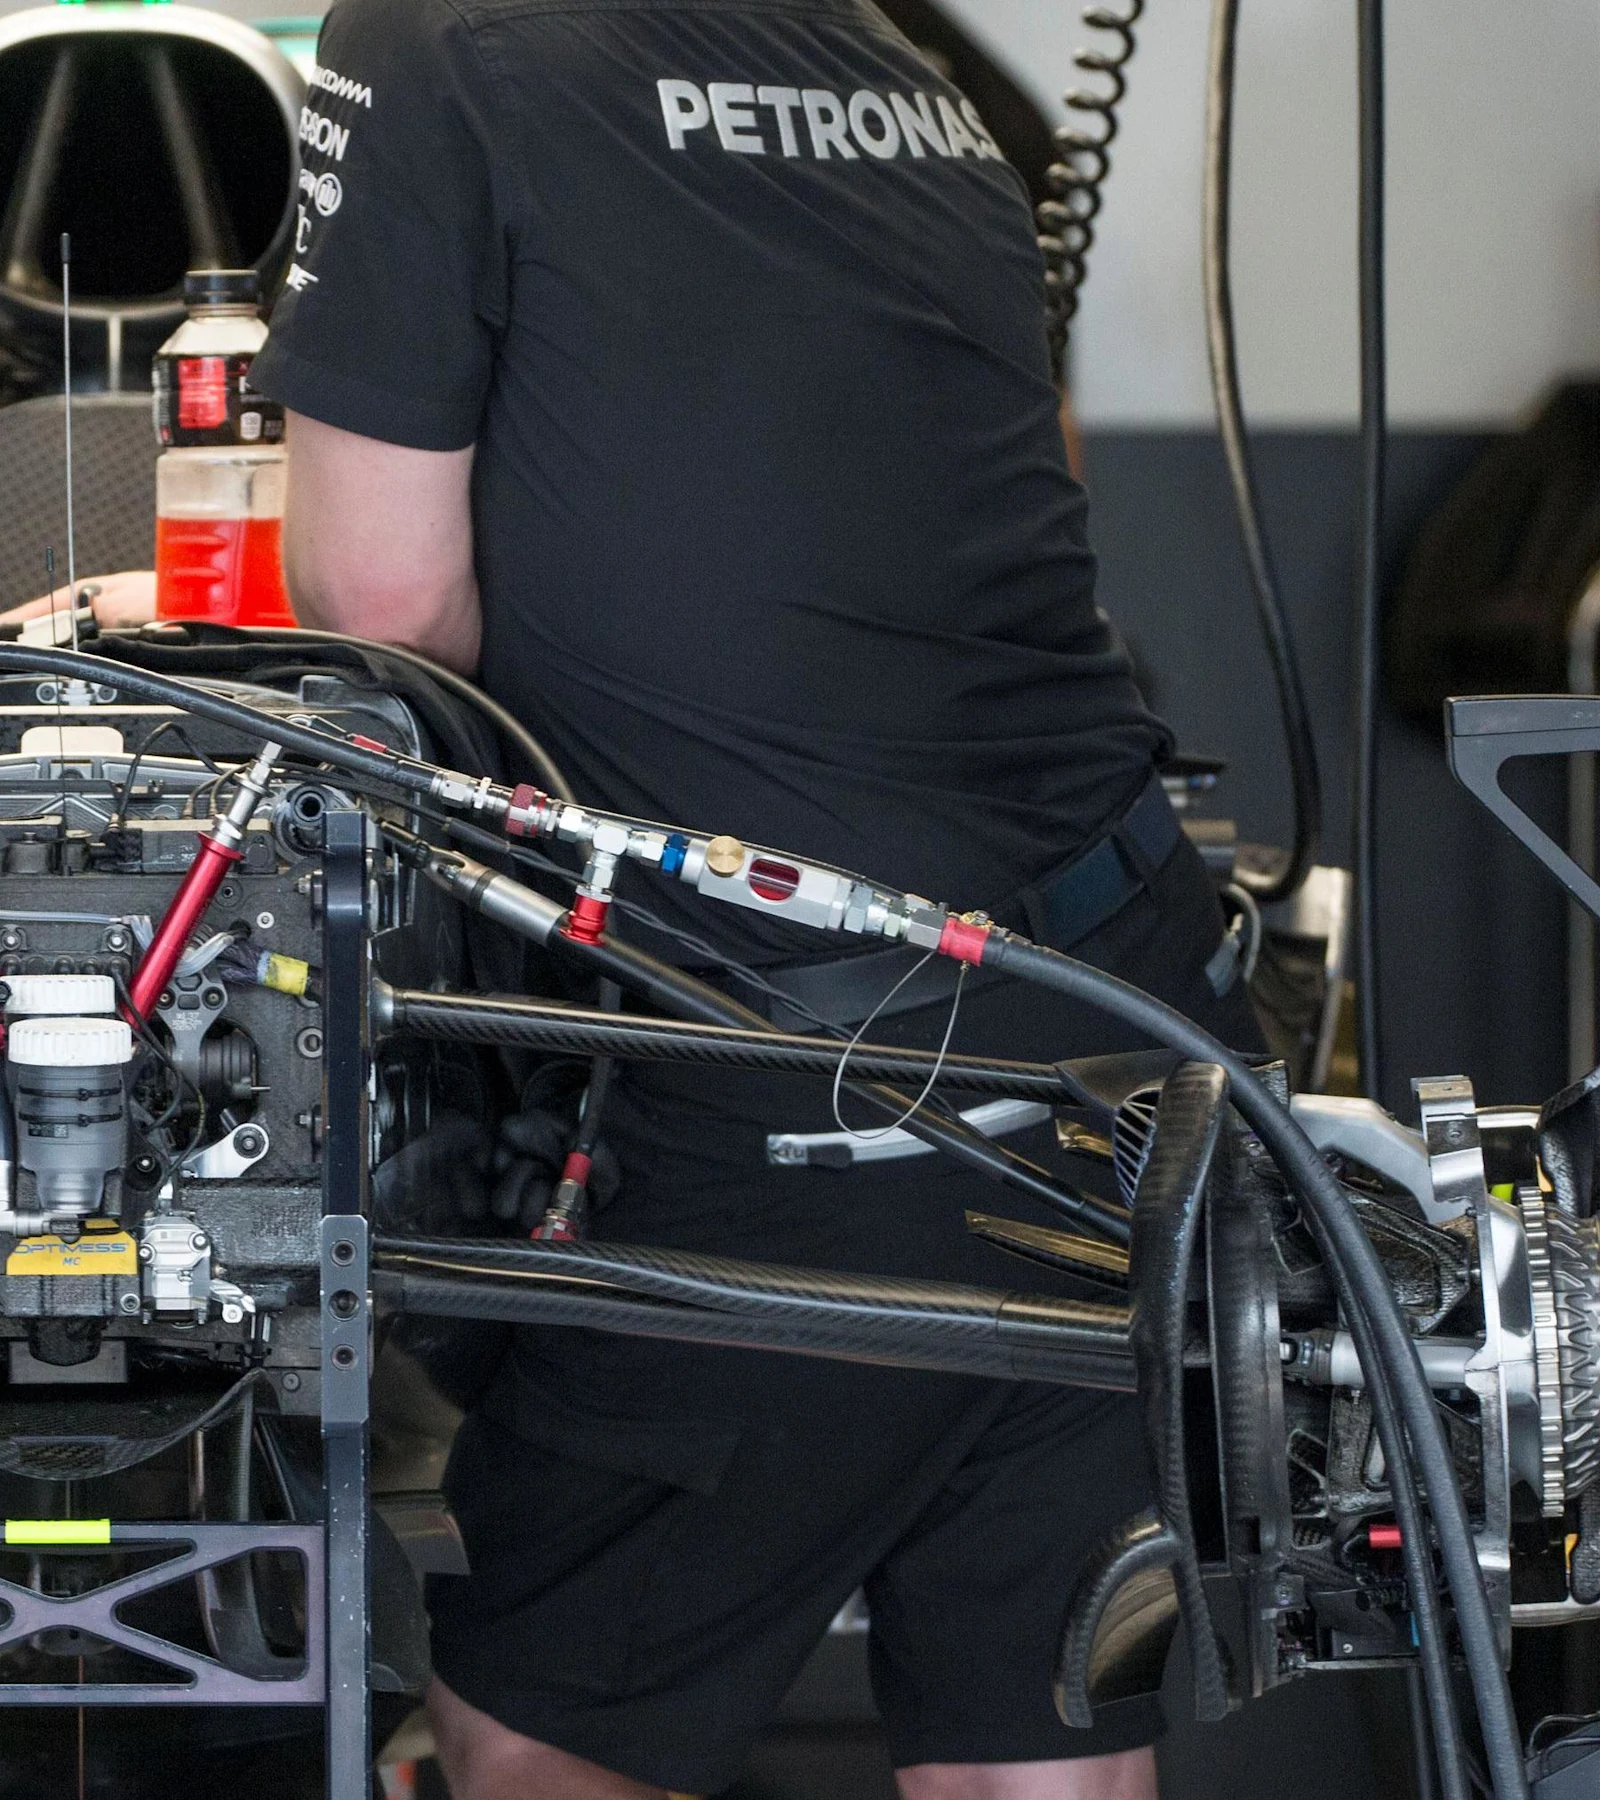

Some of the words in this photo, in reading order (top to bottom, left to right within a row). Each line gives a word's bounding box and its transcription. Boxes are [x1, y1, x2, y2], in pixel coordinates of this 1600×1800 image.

[656, 78, 1005, 161] PETRONAS
[13, 1242, 128, 1255] OPTIMESS
[62, 1257, 81, 1266] MC
